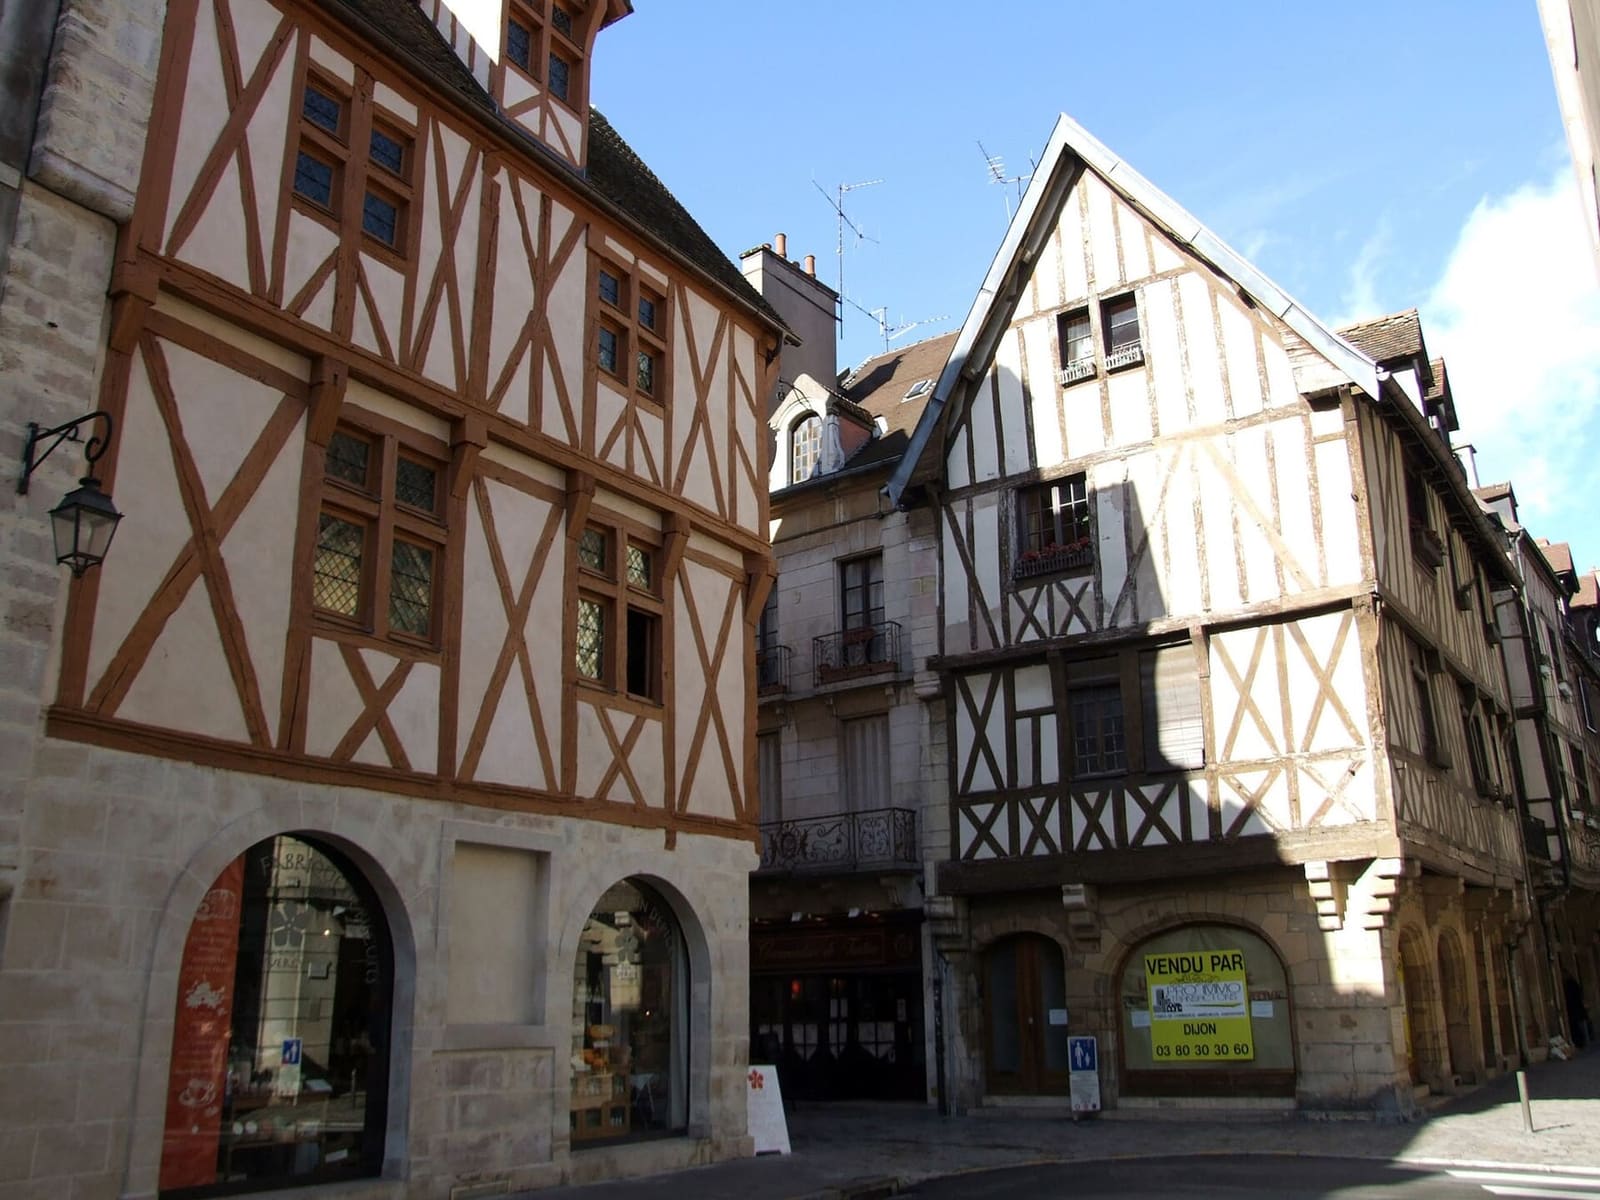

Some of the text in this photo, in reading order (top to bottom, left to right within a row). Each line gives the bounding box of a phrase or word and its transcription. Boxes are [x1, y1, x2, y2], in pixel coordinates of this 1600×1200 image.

[1146, 954, 1243, 975] VENDU PAR
[1183, 1023, 1217, 1036] DIJON
[1156, 1043, 1249, 1056] 03 80 30 30 60
